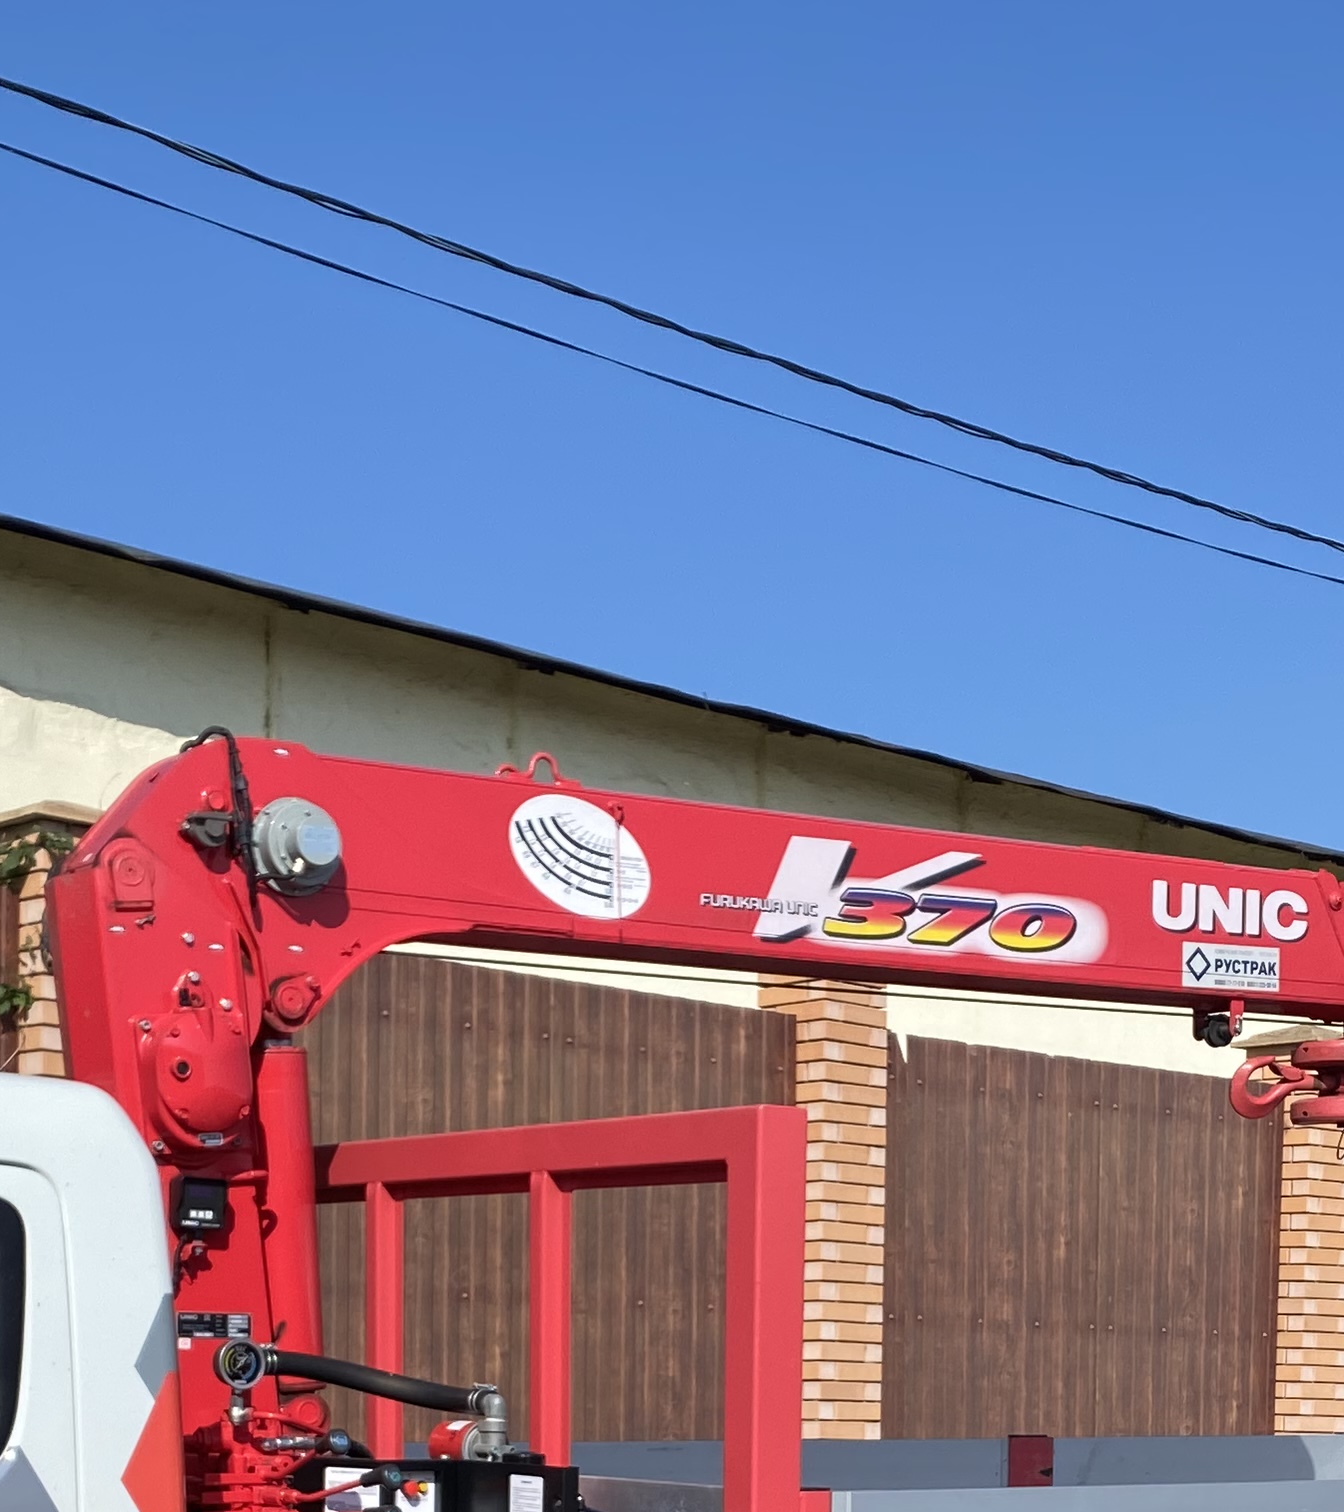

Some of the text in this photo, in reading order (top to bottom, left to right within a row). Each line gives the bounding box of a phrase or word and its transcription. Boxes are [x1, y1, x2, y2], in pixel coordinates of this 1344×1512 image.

[700, 893, 819, 917] FURUKAWA UNIC
[823, 887, 1077, 952] 370
[1152, 880, 1309, 942] UNIC
[1214, 958, 1276, 976] РУСТРАК
